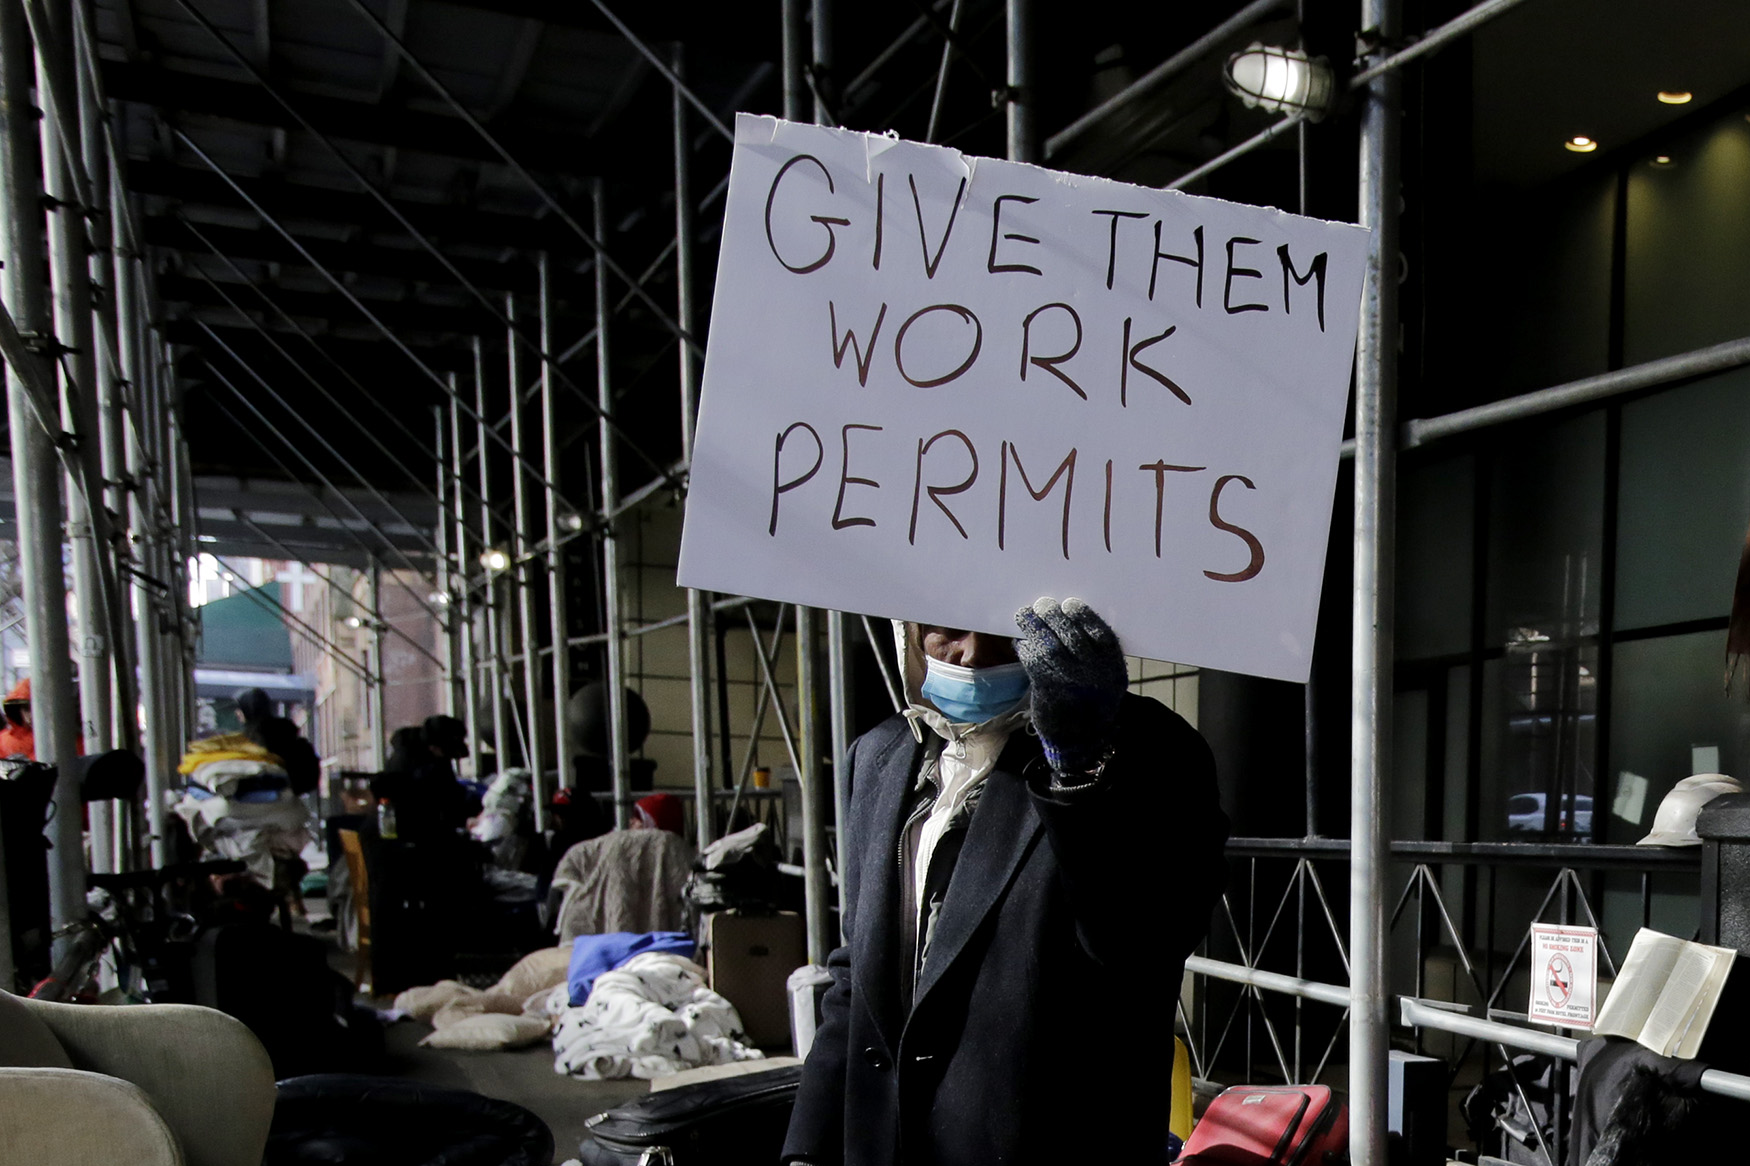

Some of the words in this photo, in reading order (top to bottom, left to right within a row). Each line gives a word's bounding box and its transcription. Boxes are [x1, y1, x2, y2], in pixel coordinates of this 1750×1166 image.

[765, 153, 1043, 280] GIVE
[1092, 209, 1328, 333] THEM
[829, 300, 1192, 408] WORK
[769, 421, 1265, 583] PERMITS
